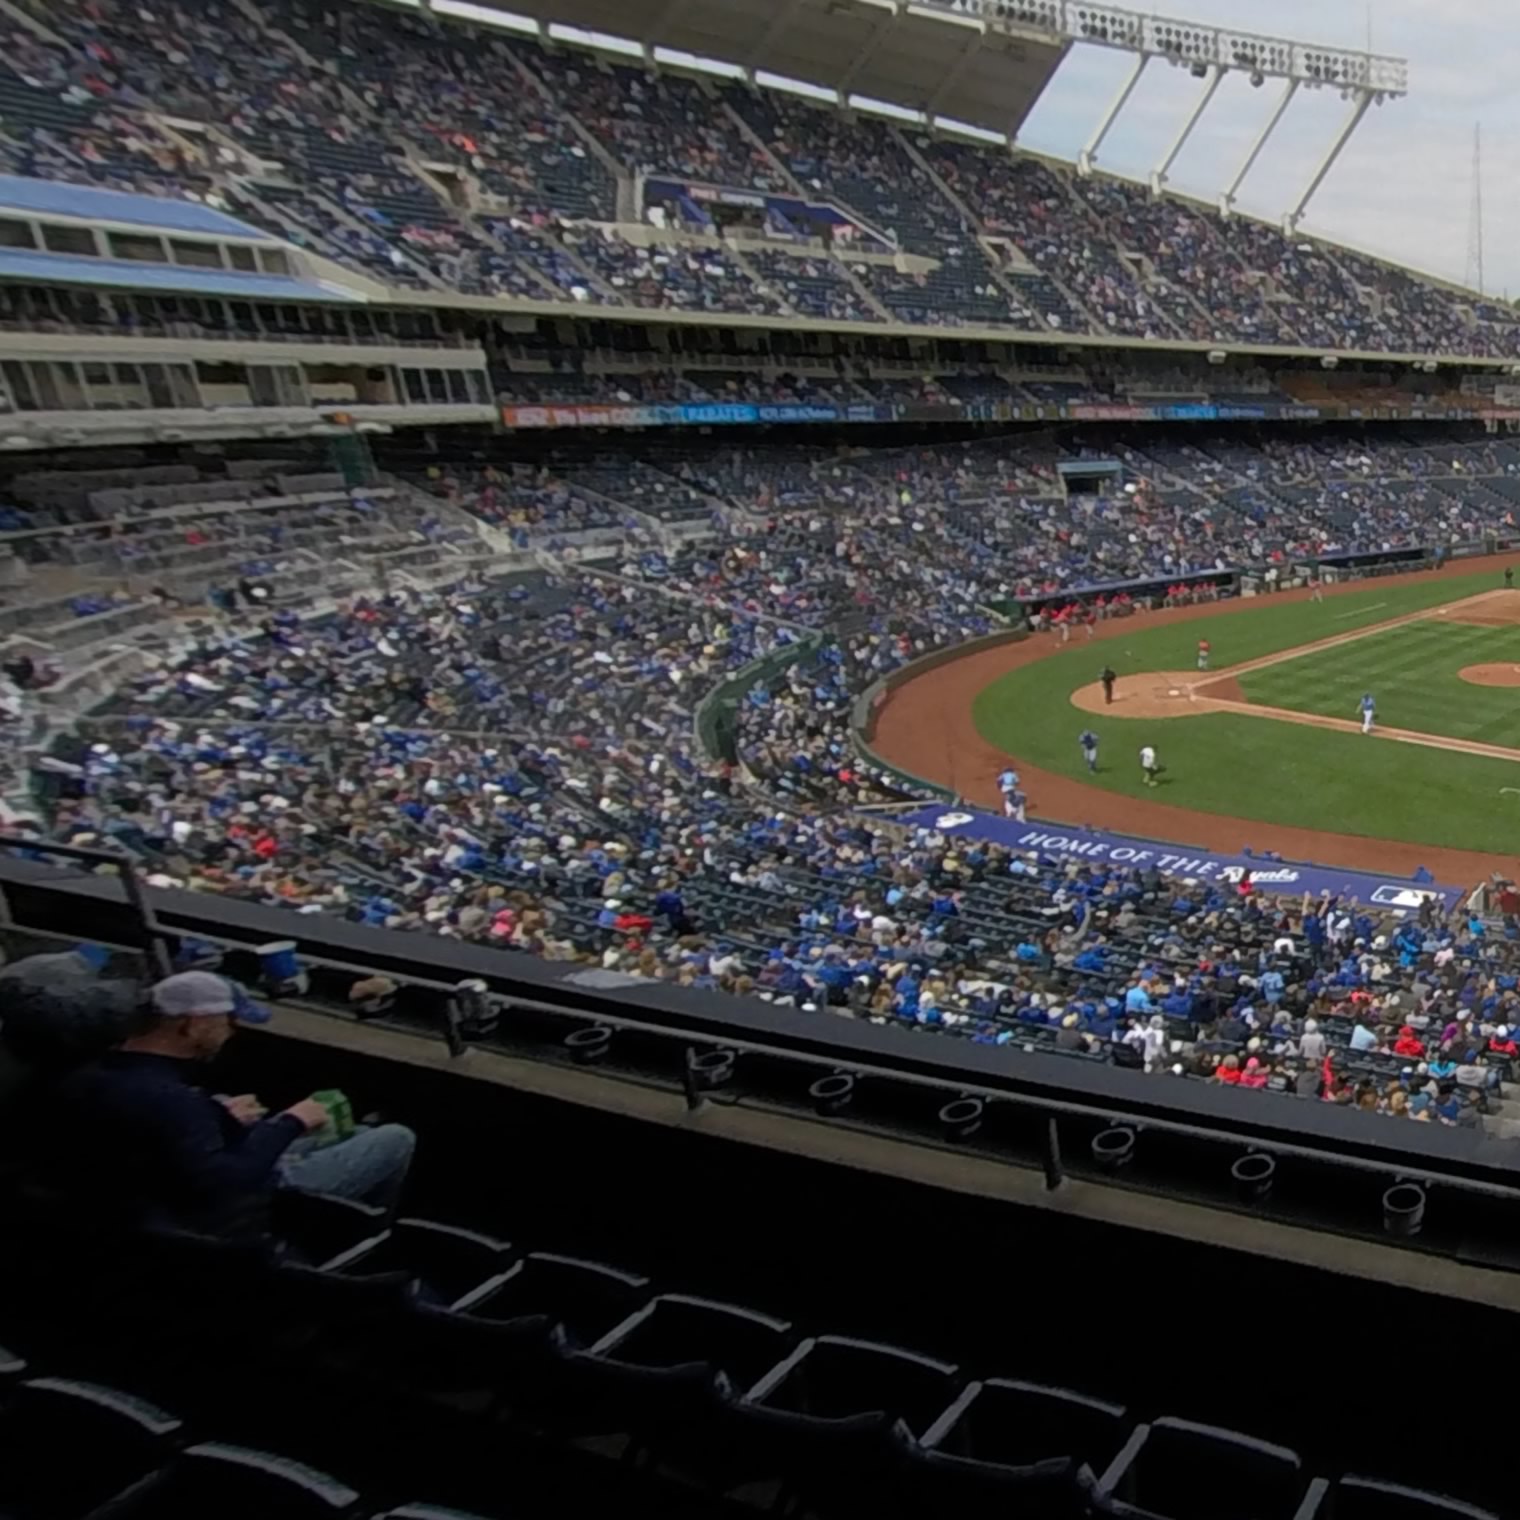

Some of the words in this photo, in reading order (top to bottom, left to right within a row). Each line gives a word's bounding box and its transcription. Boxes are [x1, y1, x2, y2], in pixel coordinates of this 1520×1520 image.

[1018, 831, 1107, 856] HOME
[1109, 847, 1152, 862] OF
[1154, 854, 1218, 876] THE
[1215, 866, 1300, 882] Ryals
